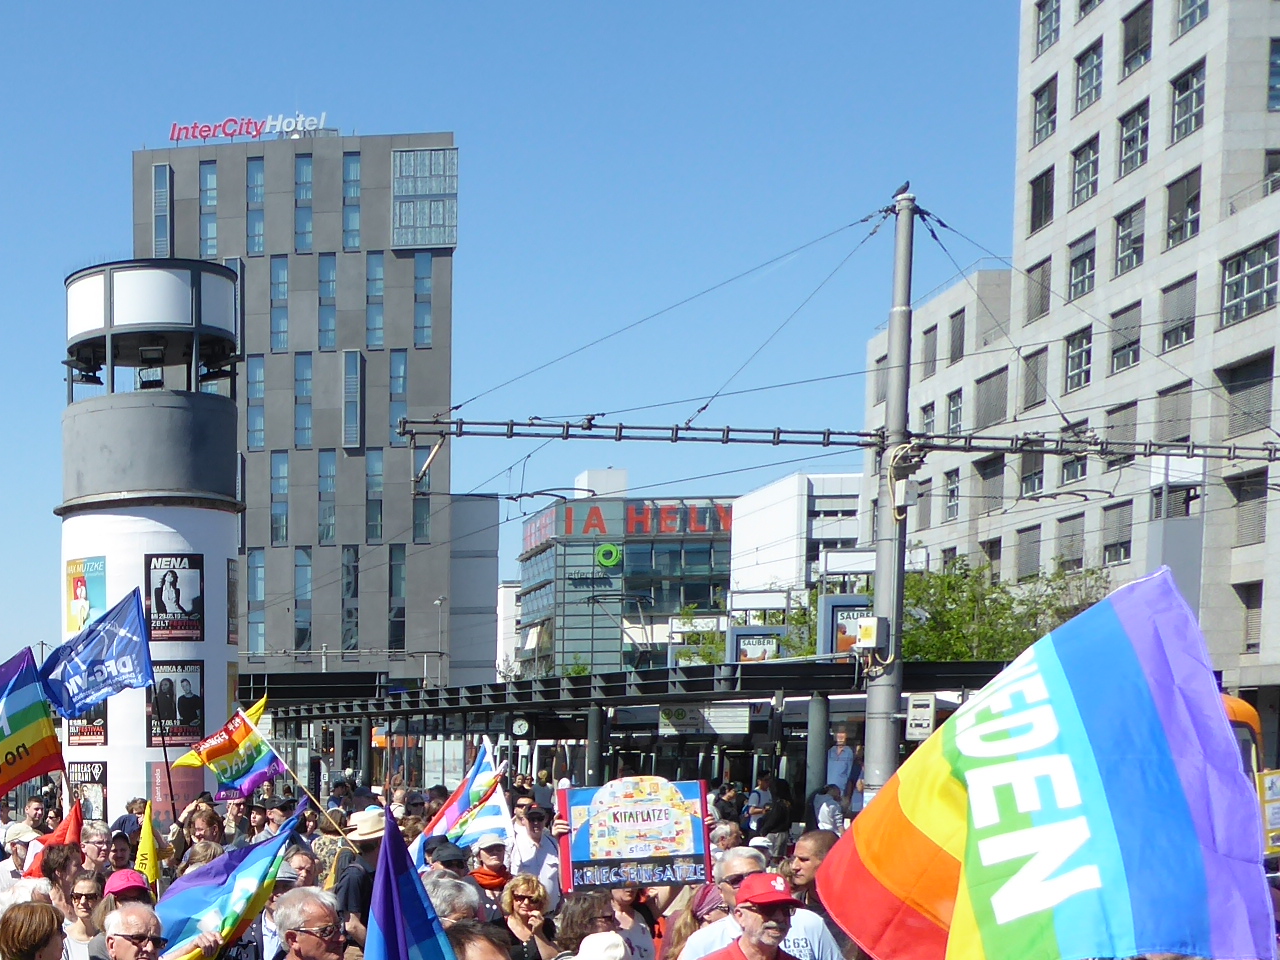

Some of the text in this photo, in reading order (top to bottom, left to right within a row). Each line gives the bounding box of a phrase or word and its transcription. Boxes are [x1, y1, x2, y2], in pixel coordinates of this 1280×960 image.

[170, 111, 326, 141] InterCityHotel
[151, 557, 190, 569] NENA
[183, 665, 200, 673] JORIS
[629, 844, 653, 854] statt
